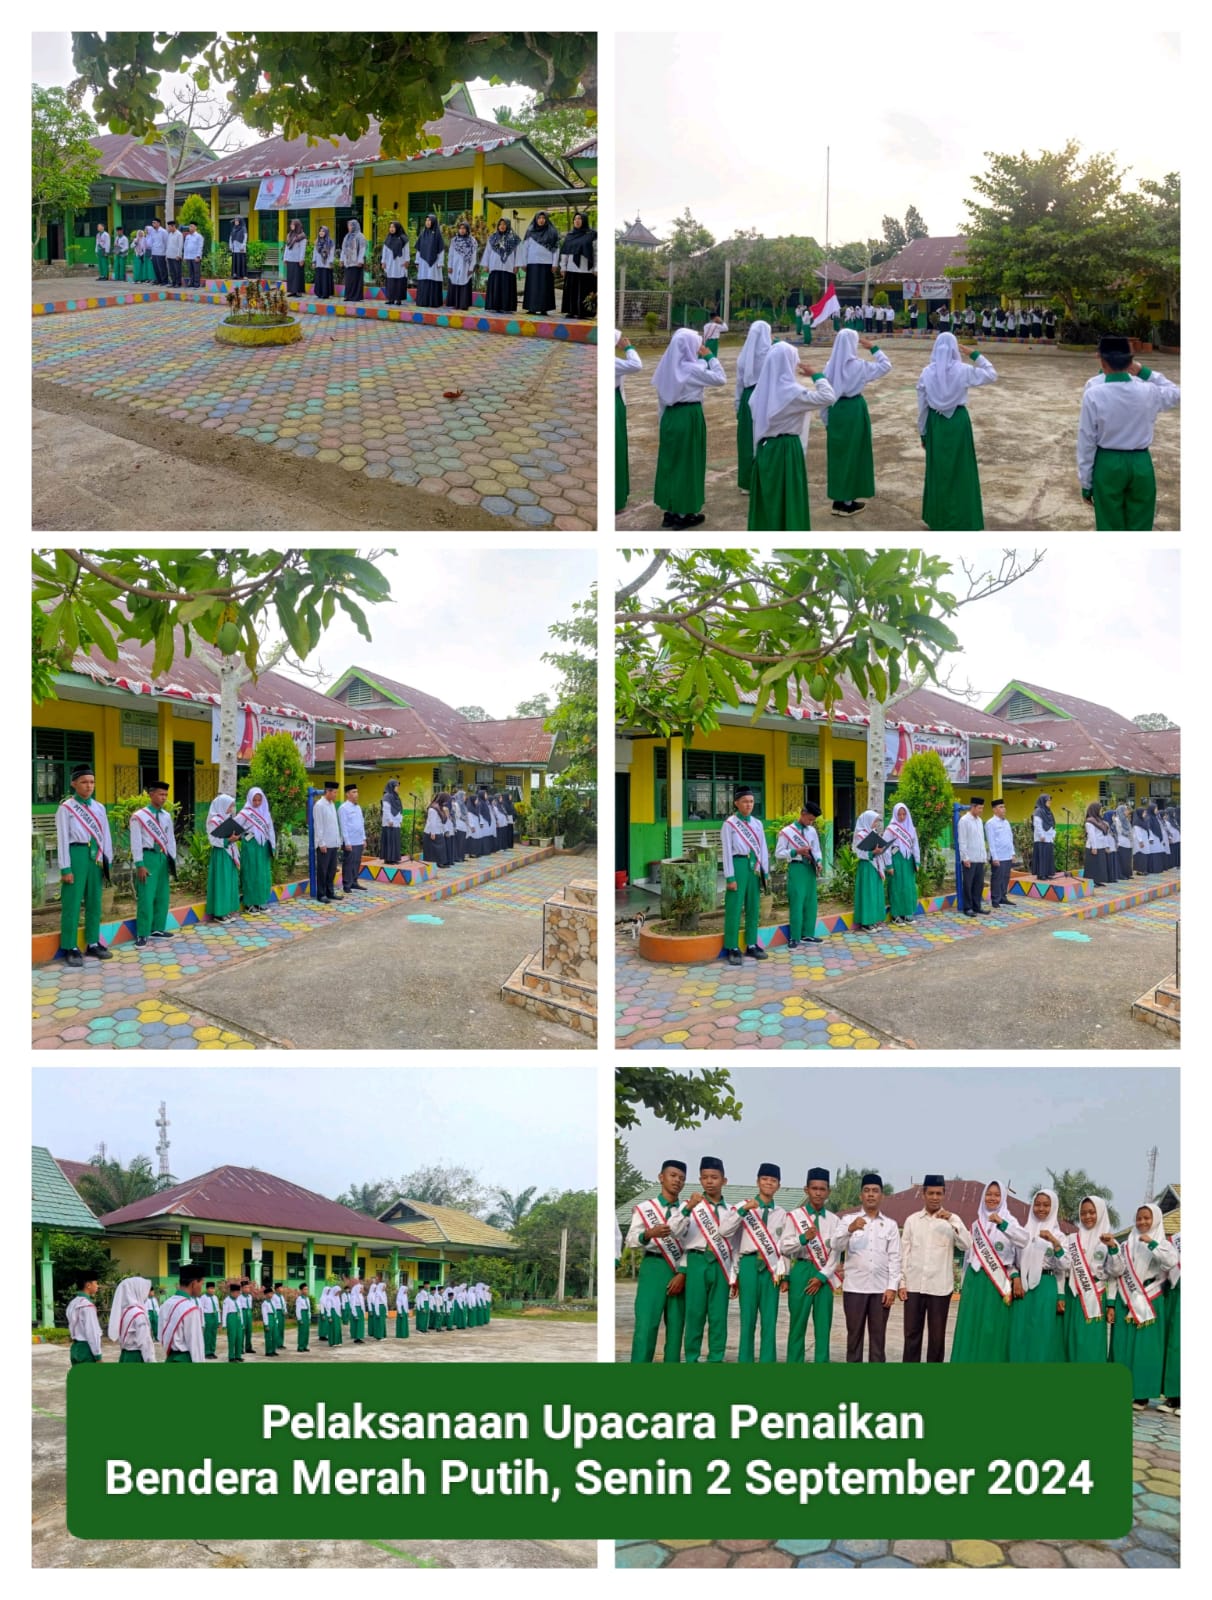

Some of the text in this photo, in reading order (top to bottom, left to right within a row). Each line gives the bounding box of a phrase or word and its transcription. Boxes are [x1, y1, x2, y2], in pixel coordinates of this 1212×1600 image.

[295, 177, 344, 189] PRAMUKA
[74, 804, 93, 825] PETUGAS
[645, 1209, 661, 1226] PETU
[697, 1208, 729, 1261] PETUGAS UPACARA
[745, 1210, 774, 1256] TUGAS UPACARA
[980, 1247, 999, 1273] UPACARA
[1069, 1241, 1092, 1292] PETUGAS UPACARA
